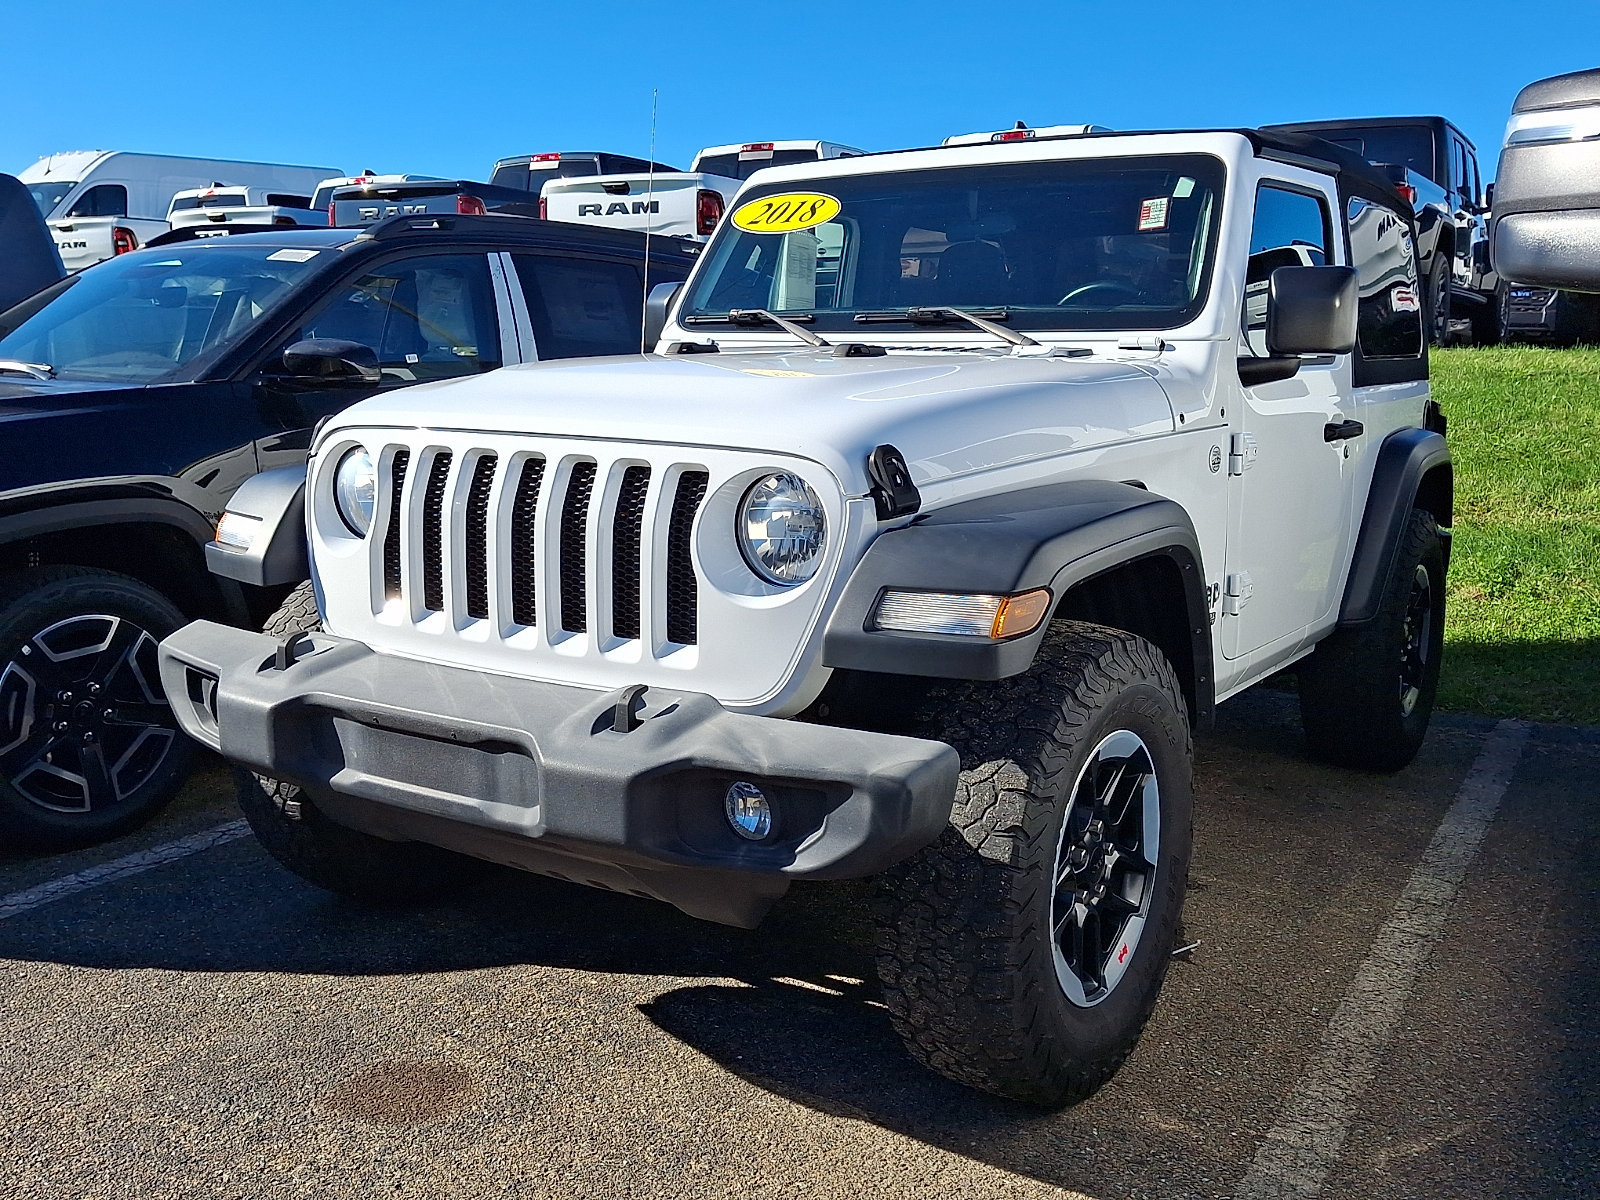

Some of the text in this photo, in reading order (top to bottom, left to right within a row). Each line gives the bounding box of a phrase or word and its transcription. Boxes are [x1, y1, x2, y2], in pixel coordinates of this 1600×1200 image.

[358, 204, 428, 221] RAM
[578, 201, 660, 217] RAM
[746, 198, 826, 226] 2018
